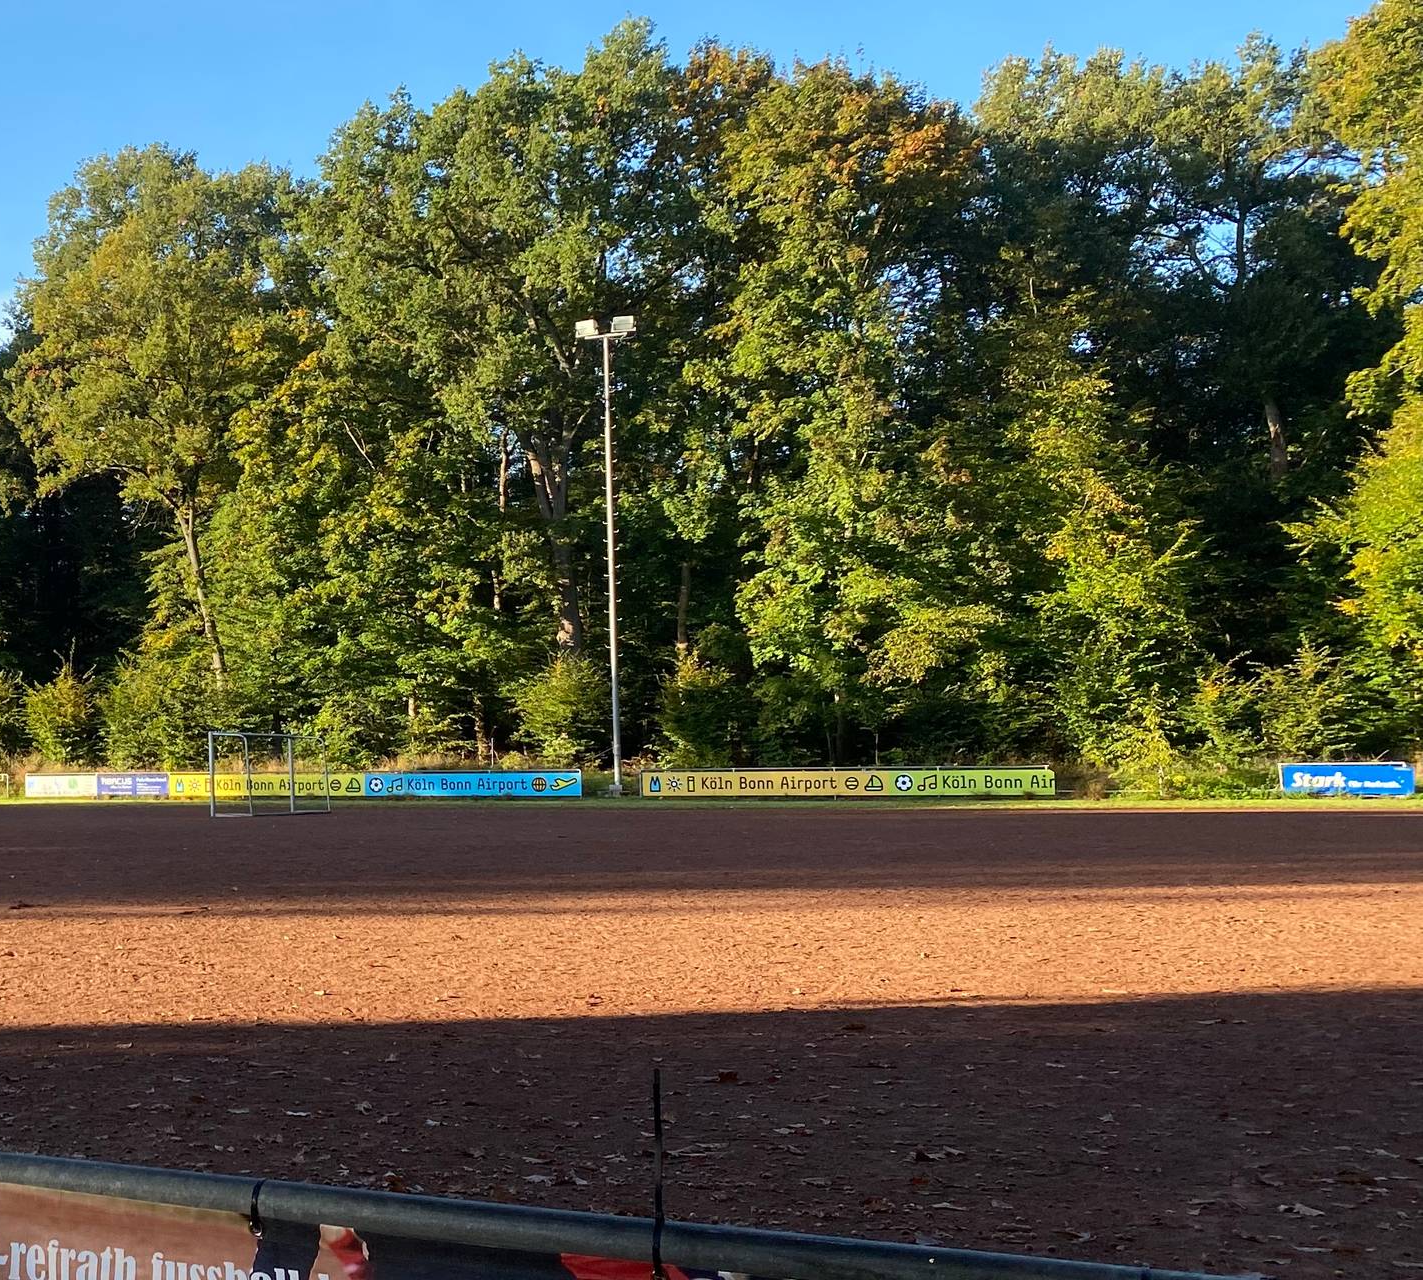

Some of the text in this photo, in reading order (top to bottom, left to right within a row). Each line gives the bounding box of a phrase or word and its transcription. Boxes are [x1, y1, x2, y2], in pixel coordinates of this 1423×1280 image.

[216, 778, 324, 793] Köln Bonn Airport
[407, 777, 527, 794] Köln Bonn Airport
[701, 776, 837, 793] Köln Bonn Airport
[942, 775, 1056, 789] Köln Bonn Air
[1291, 771, 1346, 788] Stark
